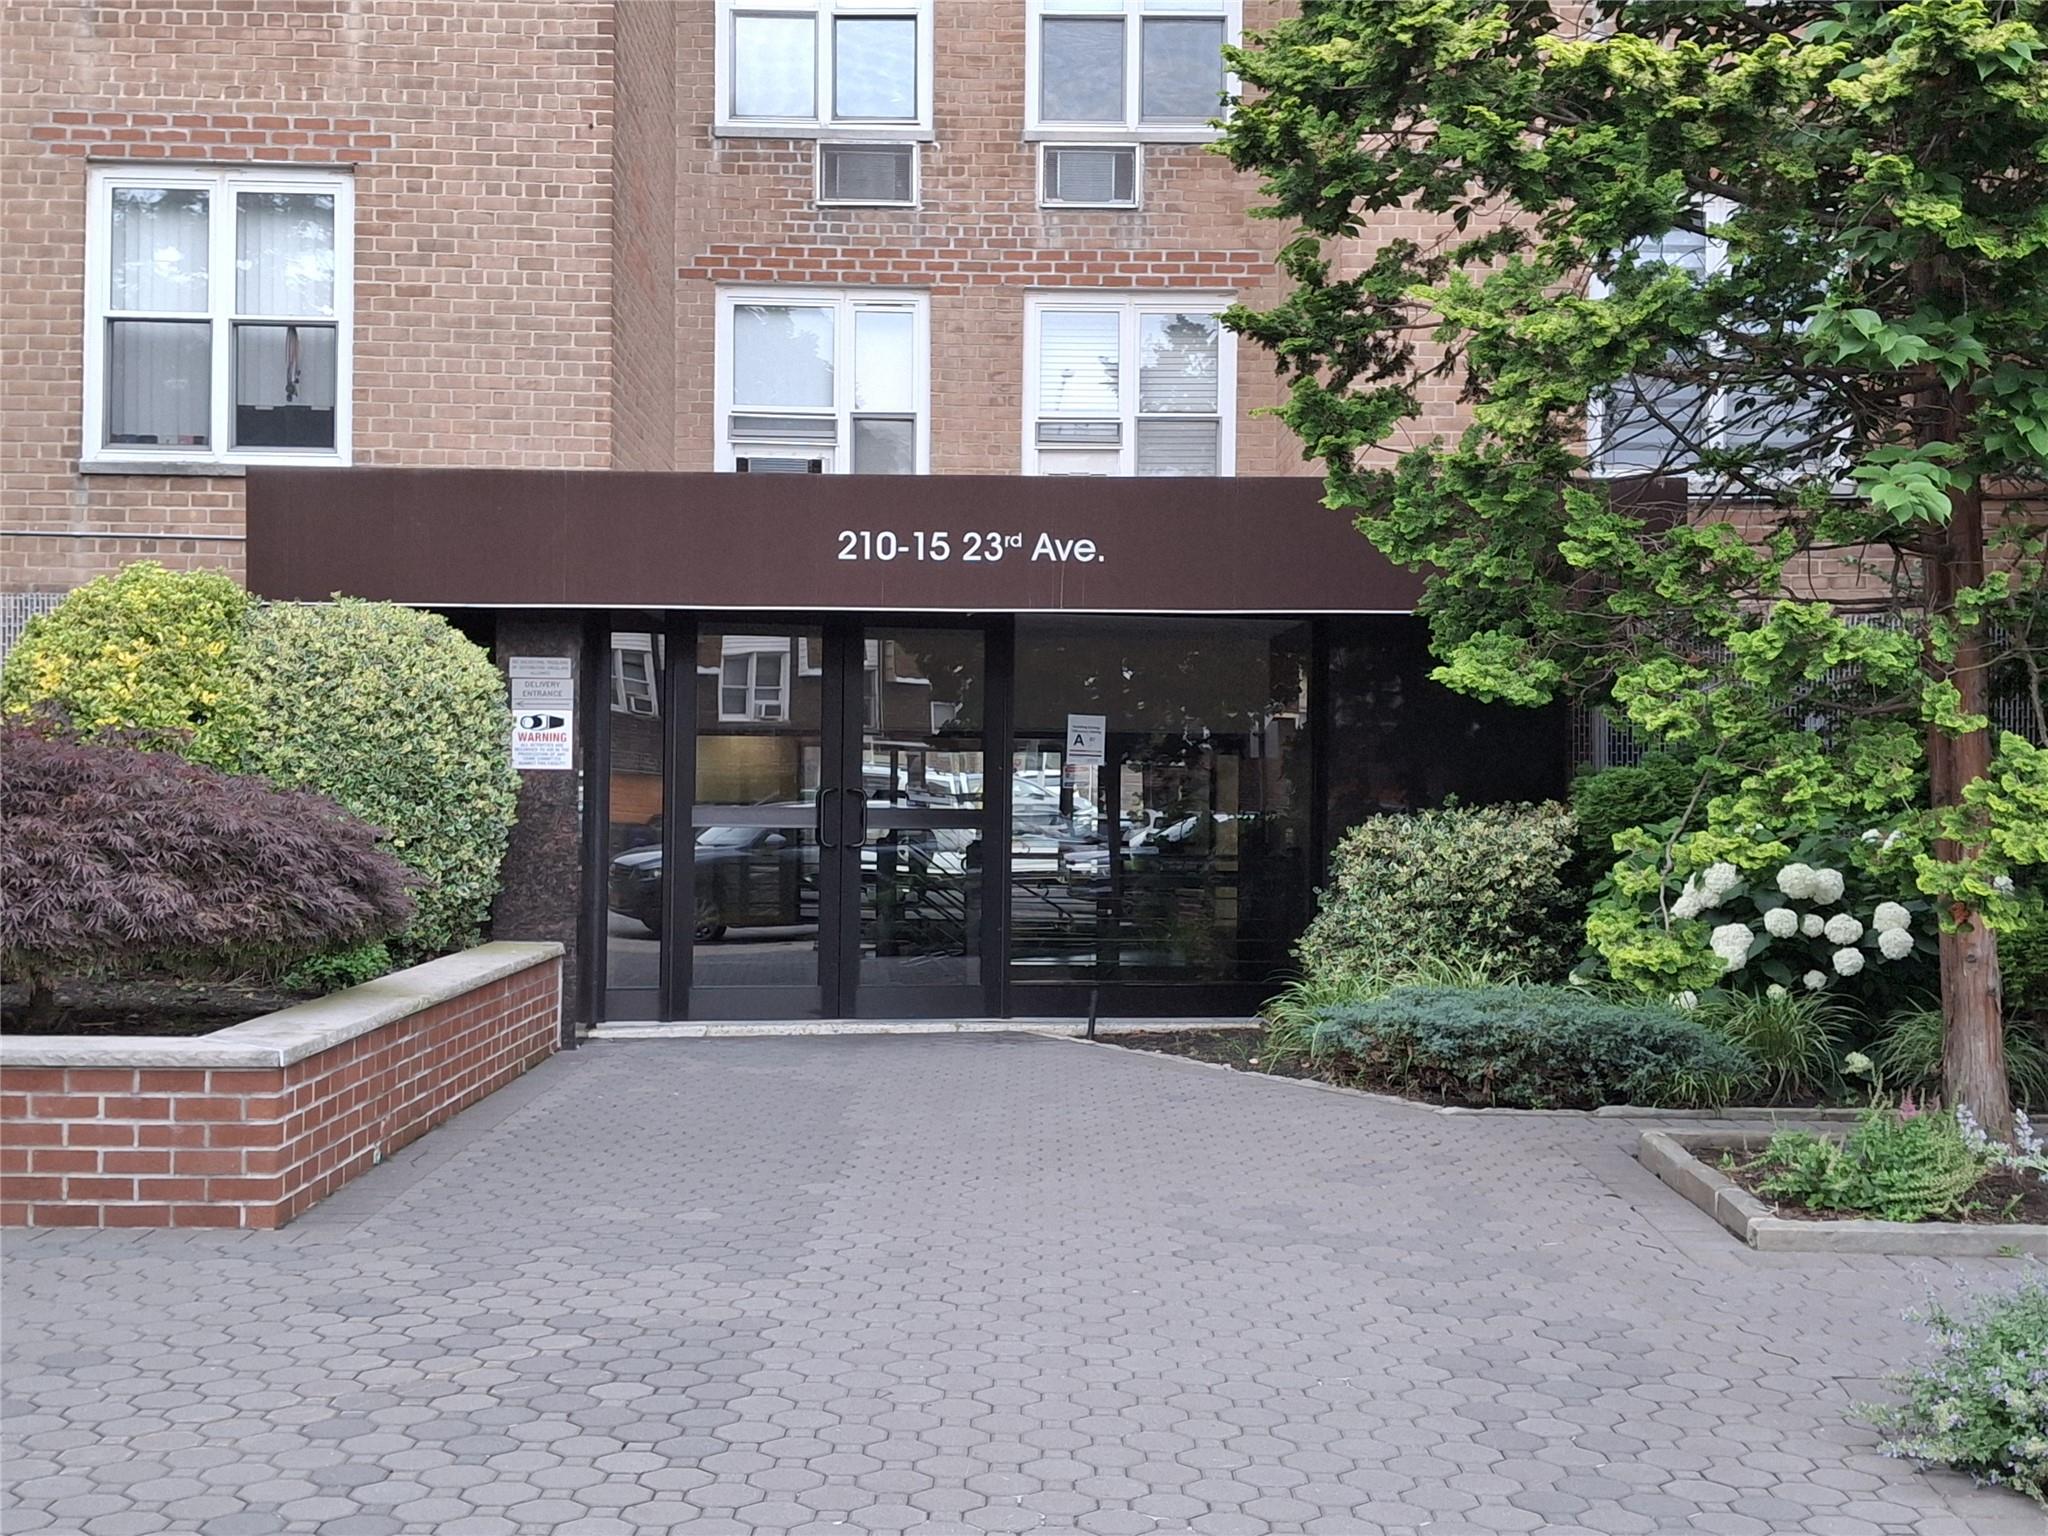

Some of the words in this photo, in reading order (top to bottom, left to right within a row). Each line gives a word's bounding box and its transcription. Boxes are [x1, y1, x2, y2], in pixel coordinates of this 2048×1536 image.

[837, 530, 951, 561] 210-15
[962, 531, 1023, 562] 23rd
[1031, 532, 1105, 563] Ave.
[517, 732, 567, 742] WARNING
[1073, 734, 1085, 746] A
